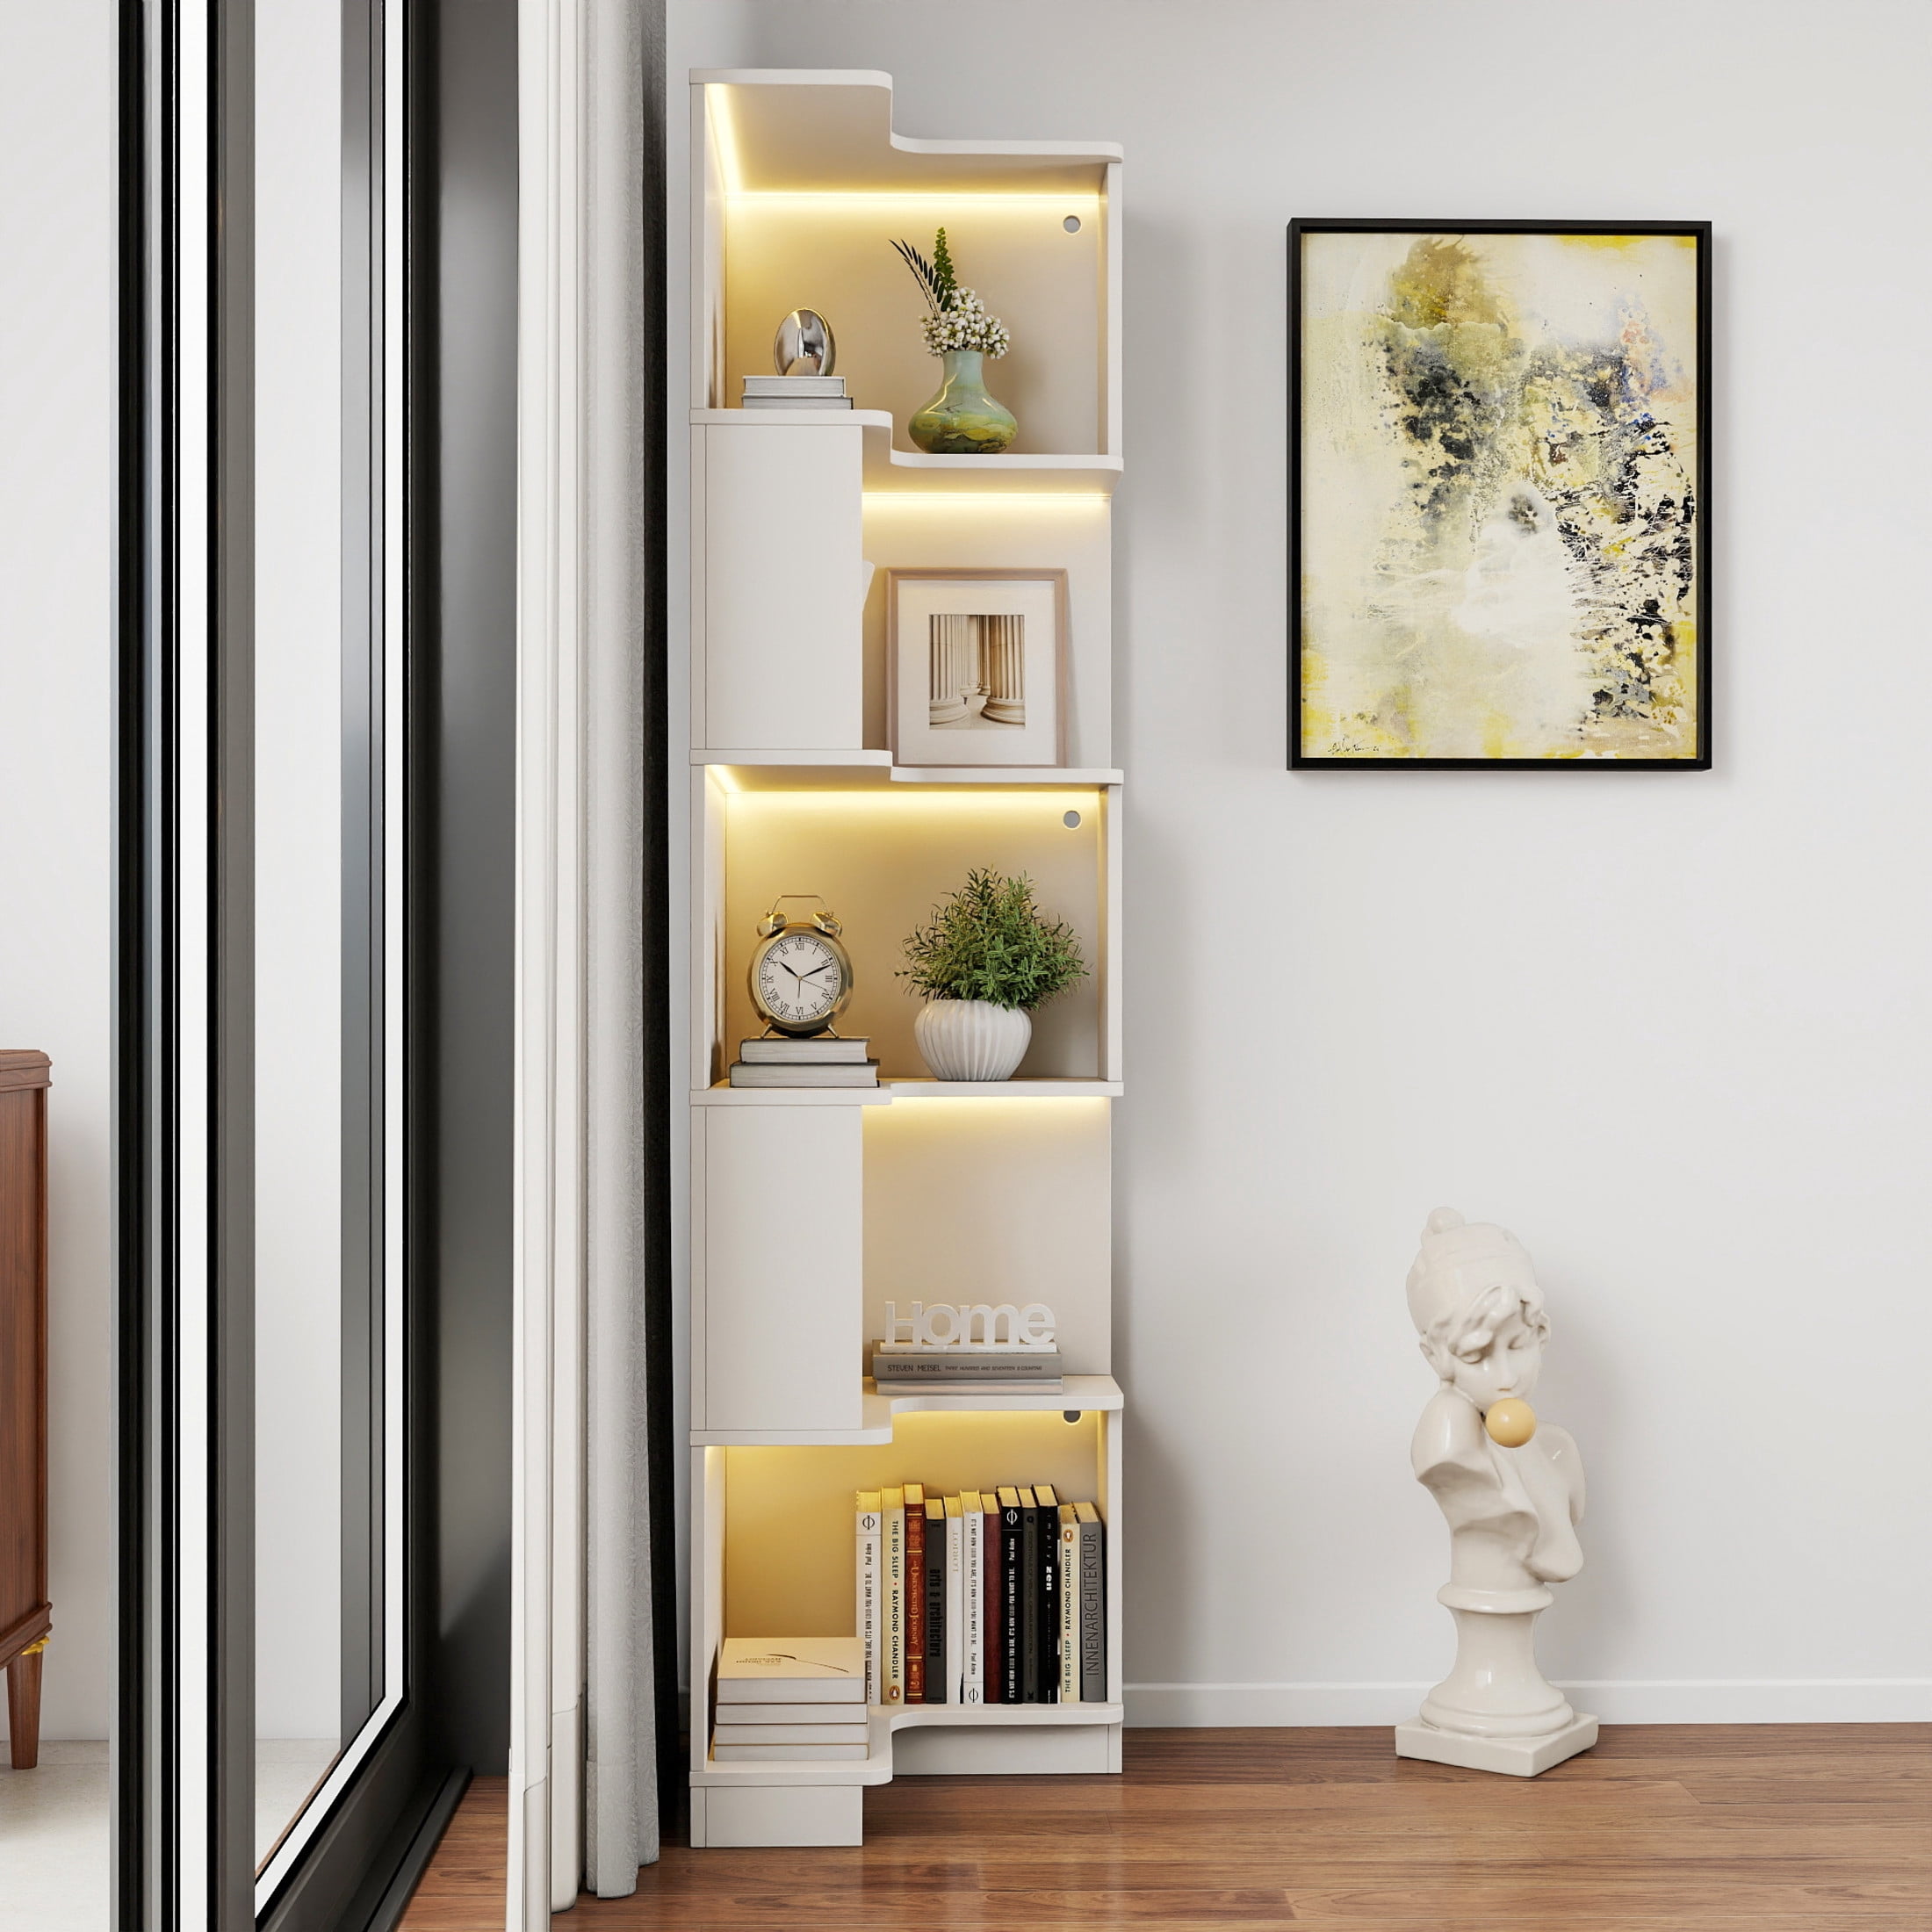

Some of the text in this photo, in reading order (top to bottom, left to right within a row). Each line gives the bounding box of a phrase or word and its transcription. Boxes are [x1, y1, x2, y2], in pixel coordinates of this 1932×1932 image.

[780, 947, 789, 956] XI
[795, 942, 805, 951] XII
[766, 975, 775, 984] IX
[769, 988, 781, 1001] VIII
[780, 1001, 790, 1012] VII
[795, 1006, 804, 1015] VI
[885, 1301, 1056, 1345] Home
[929, 1569, 942, 1587] arts
[1083, 1533, 1099, 1676] INNENARCHITEKTUR
[929, 1602, 943, 1657] architecture
